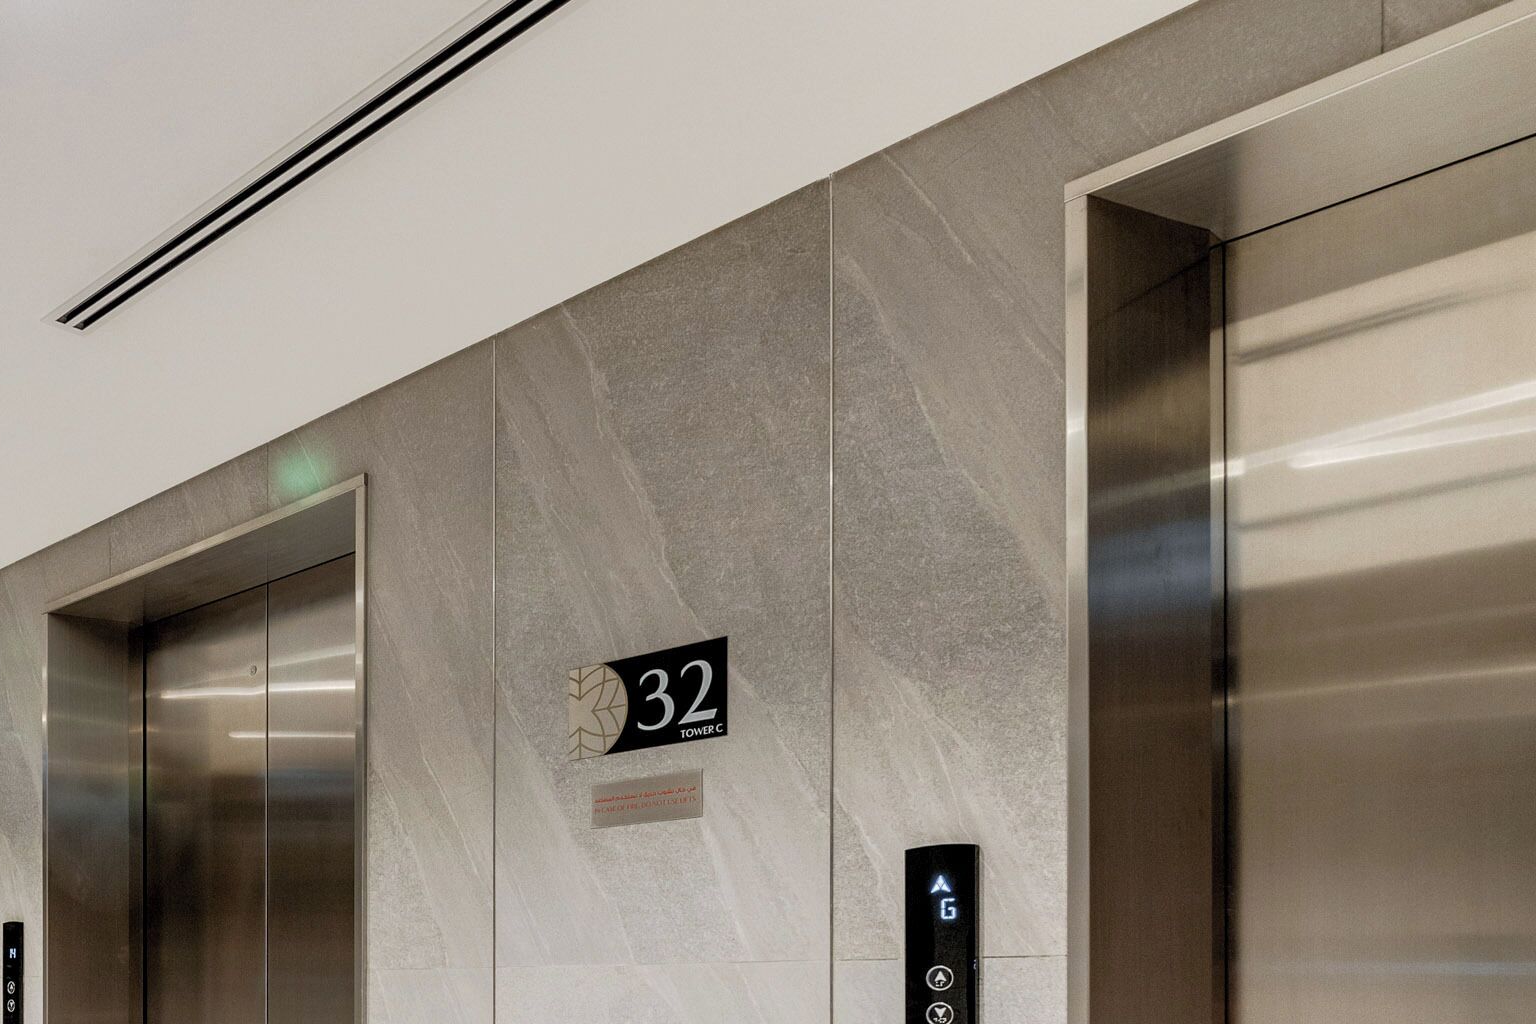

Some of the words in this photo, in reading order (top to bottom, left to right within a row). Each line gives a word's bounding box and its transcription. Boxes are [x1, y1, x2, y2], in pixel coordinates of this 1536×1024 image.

[637, 659, 718, 731] 32
[680, 725, 714, 739] TOWER
[715, 723, 724, 733] C
[941, 898, 956, 919] G
